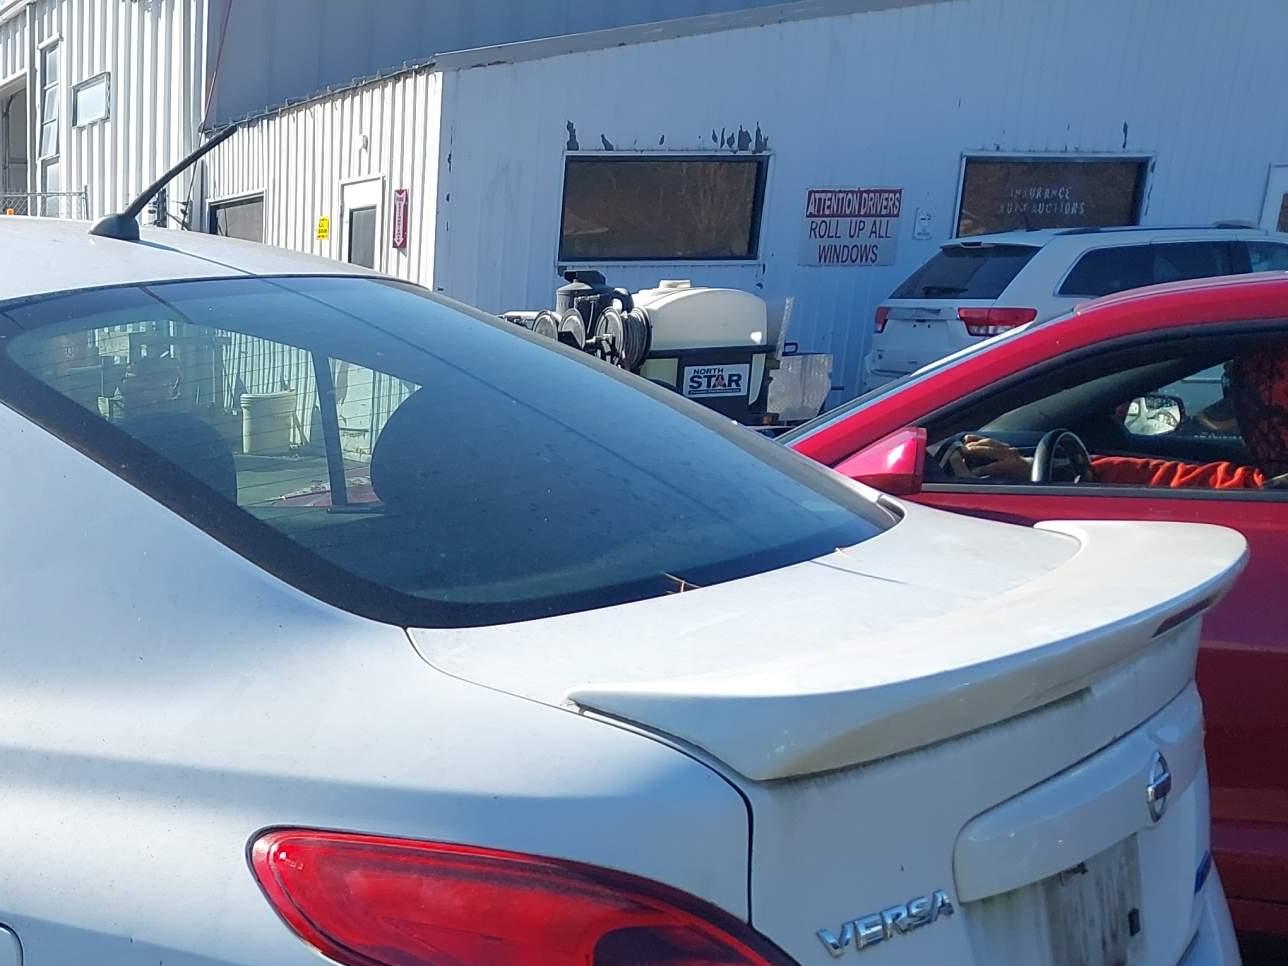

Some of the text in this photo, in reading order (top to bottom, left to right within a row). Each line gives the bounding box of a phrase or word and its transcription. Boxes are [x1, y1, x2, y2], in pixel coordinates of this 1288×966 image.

[807, 192, 900, 215] ATTENTION DRIVERS
[809, 219, 892, 239] ROLL UP ALL
[817, 244, 879, 264] WINDOWS
[689, 373, 742, 389] STAR
[693, 367, 724, 375] NORTH
[816, 889, 954, 958] VERSA
